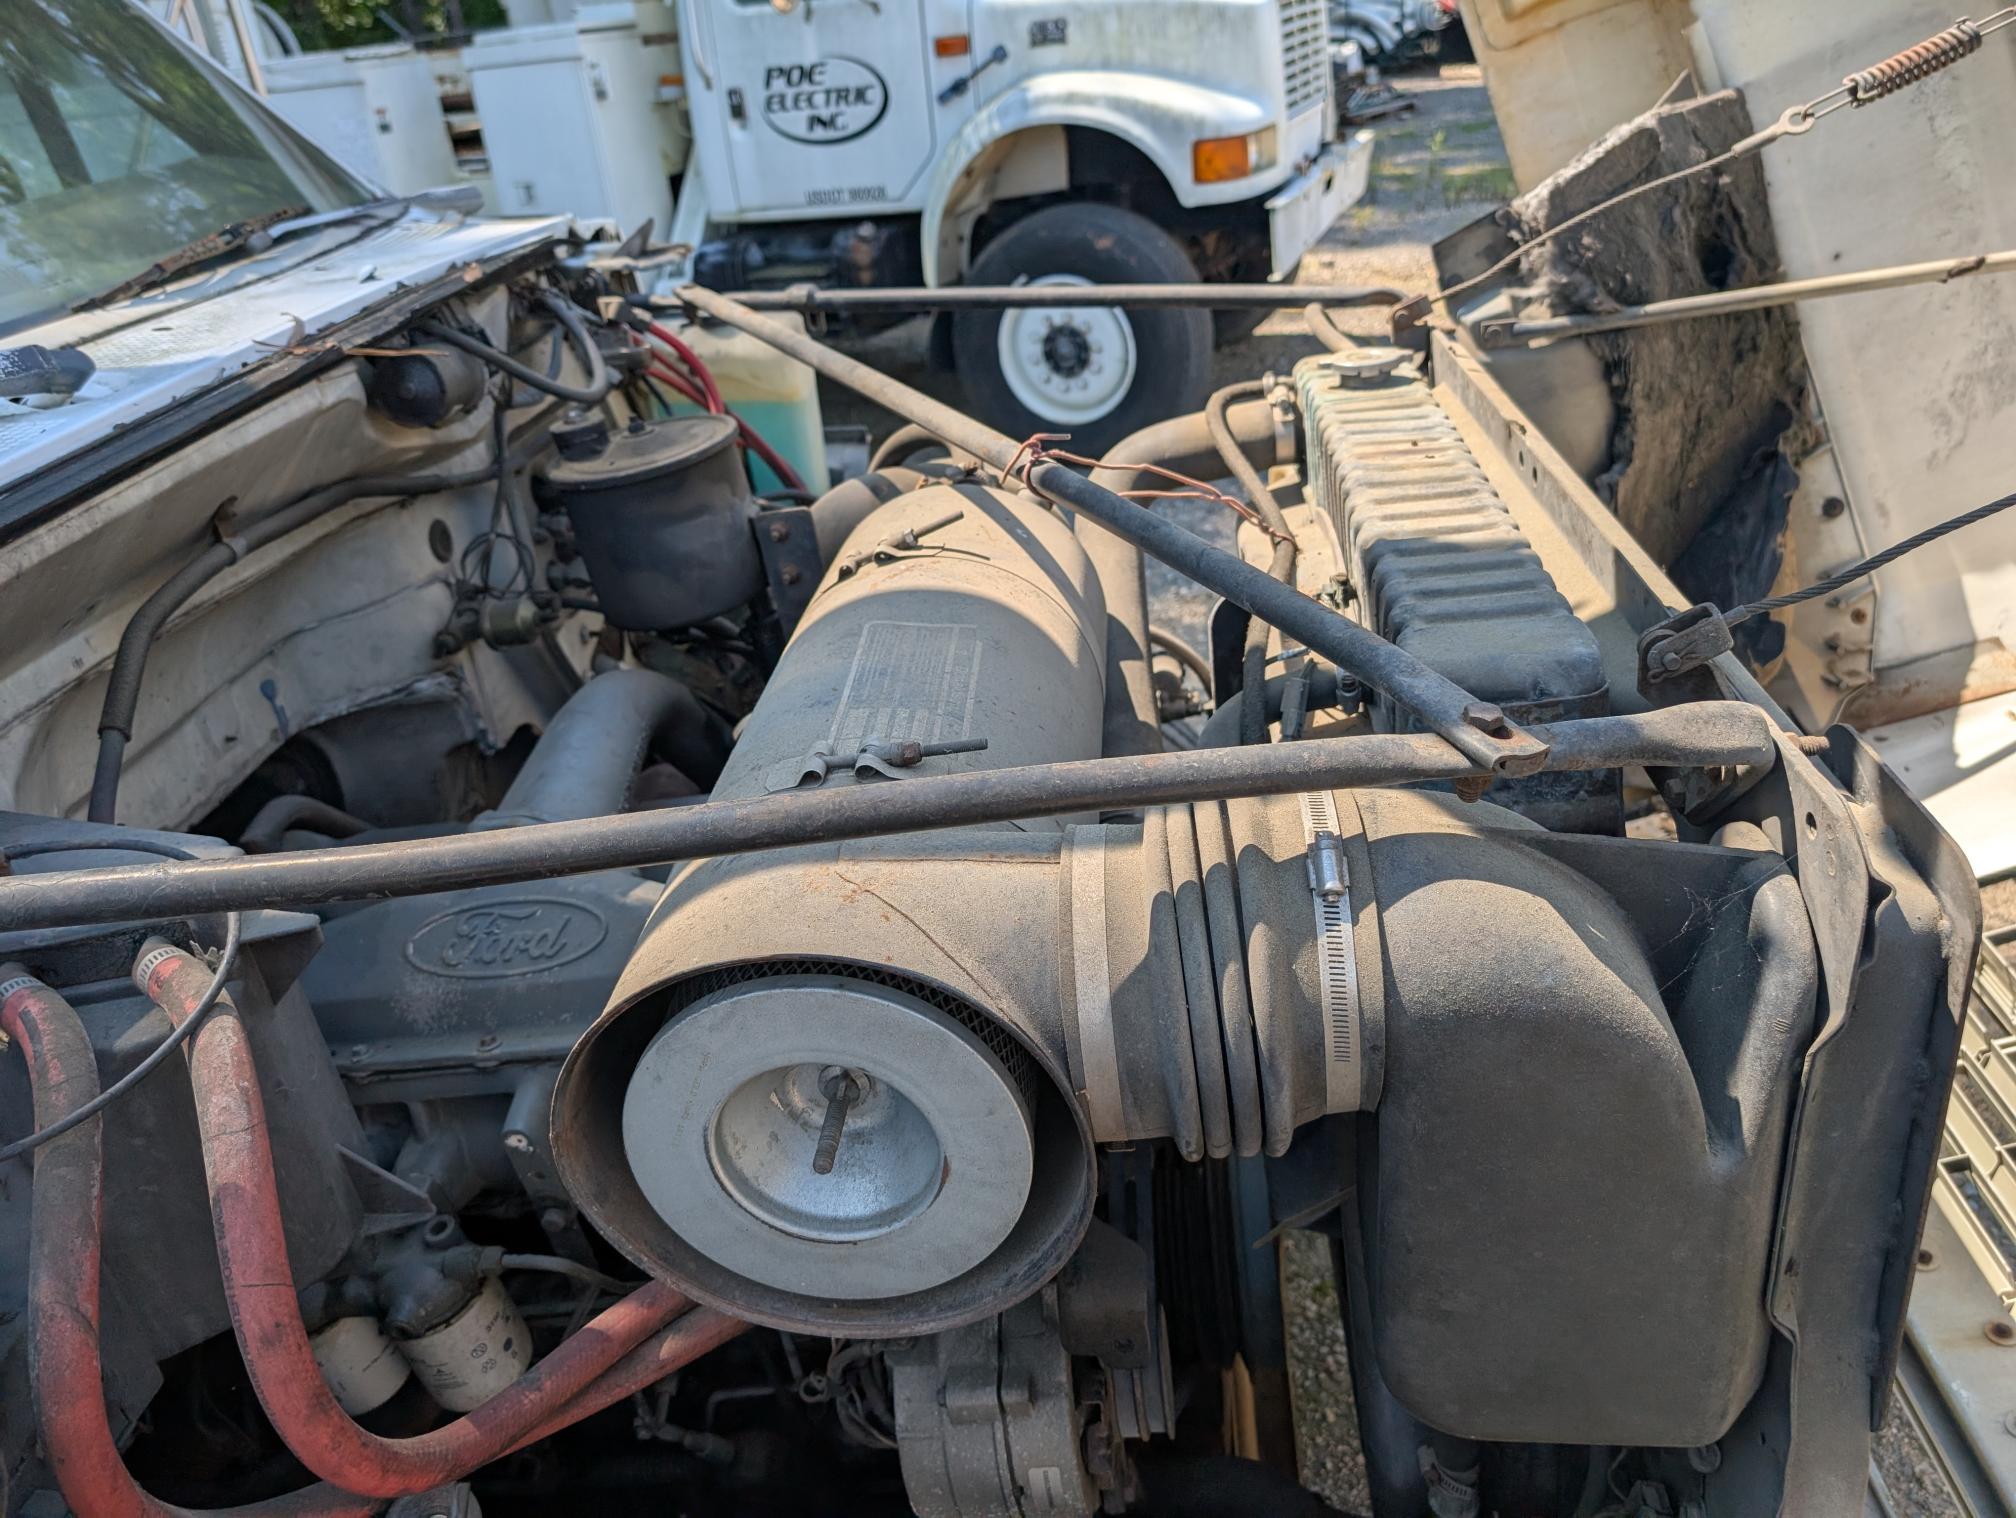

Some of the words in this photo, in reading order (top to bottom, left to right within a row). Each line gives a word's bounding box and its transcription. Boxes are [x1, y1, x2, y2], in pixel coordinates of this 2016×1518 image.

[764, 62, 828, 90] POE
[764, 84, 876, 114] ELECTRIC
[442, 906, 576, 968] Ford
